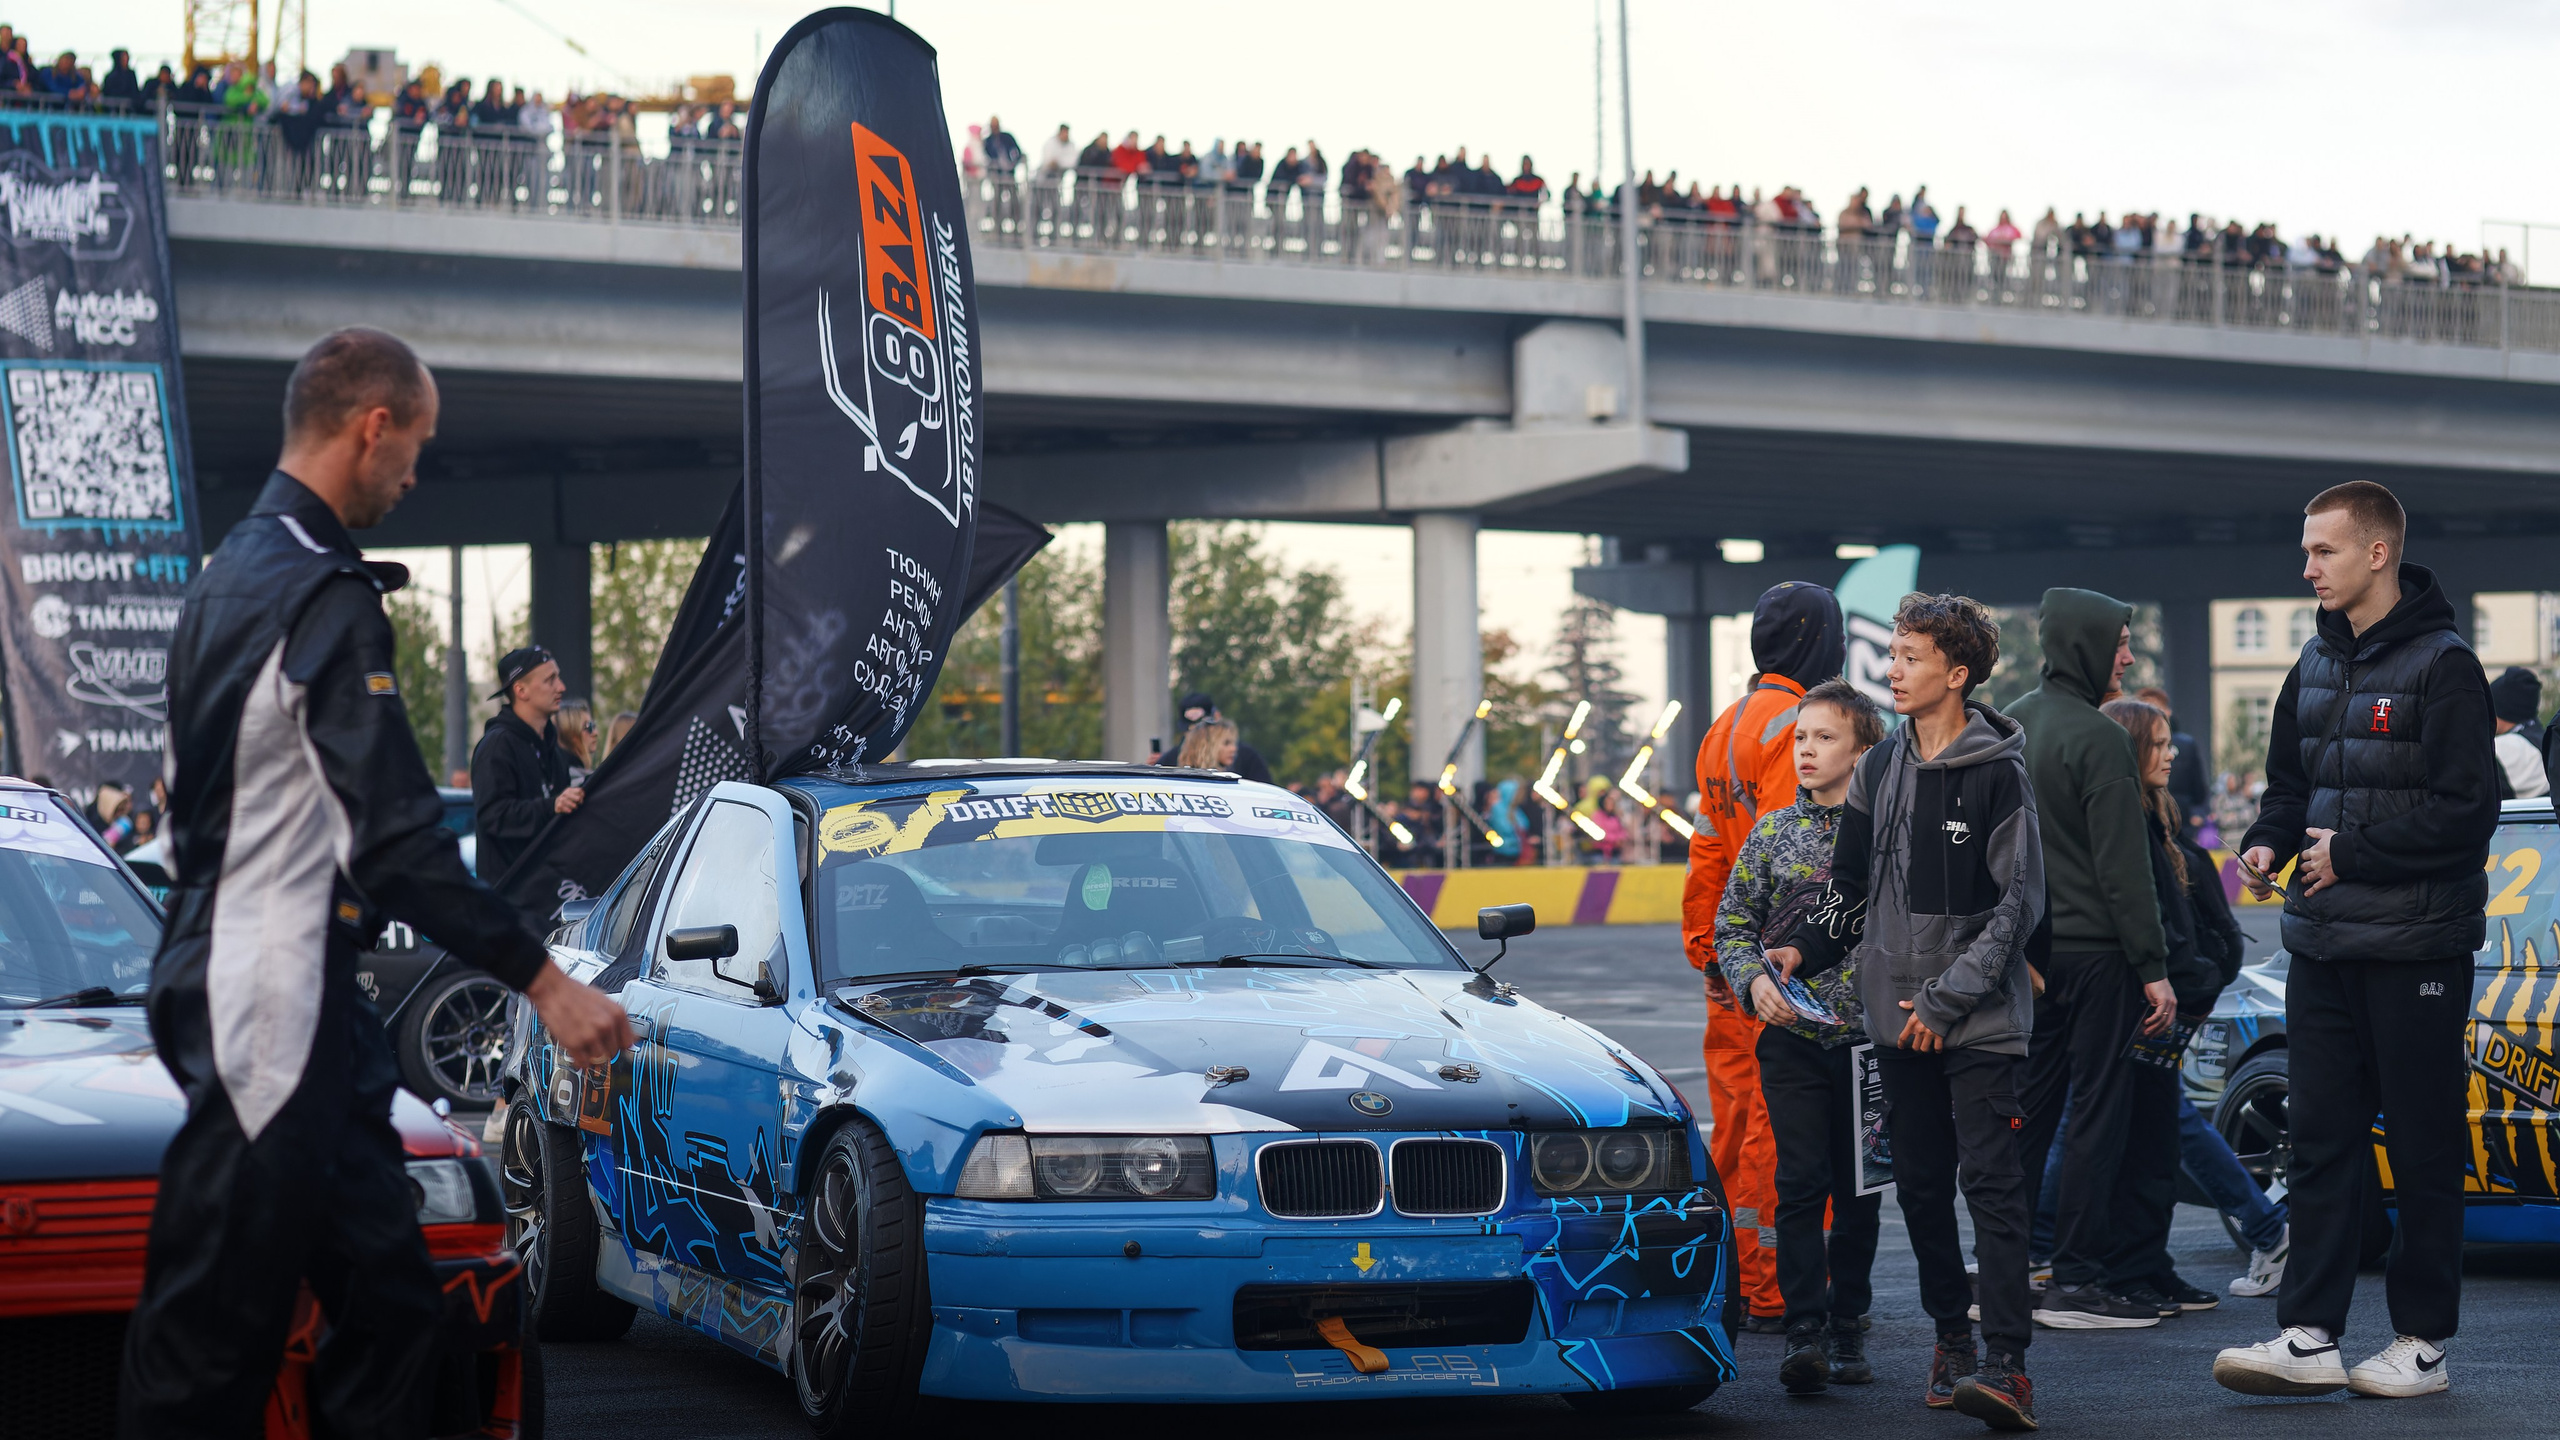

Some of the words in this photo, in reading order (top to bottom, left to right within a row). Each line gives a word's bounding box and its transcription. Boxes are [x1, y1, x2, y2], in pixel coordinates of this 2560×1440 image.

[54, 287, 159, 322] Autolab
[931, 211, 975, 523] АВТОКОМПЛЕКС
[21, 551, 135, 584] BRIGHT
[149, 554, 189, 584] FIT
[886, 548, 943, 606] ТЮНИН
[944, 795, 1055, 823] DRIFT
[1115, 792, 1234, 819] GAMES
[2419, 982, 2444, 996] GAP
[2484, 1031, 2560, 1106] DRIFT
[1295, 1374, 1370, 1388] СТУДИЯ
[1375, 1372, 1482, 1383] АВТОСВЕТА
